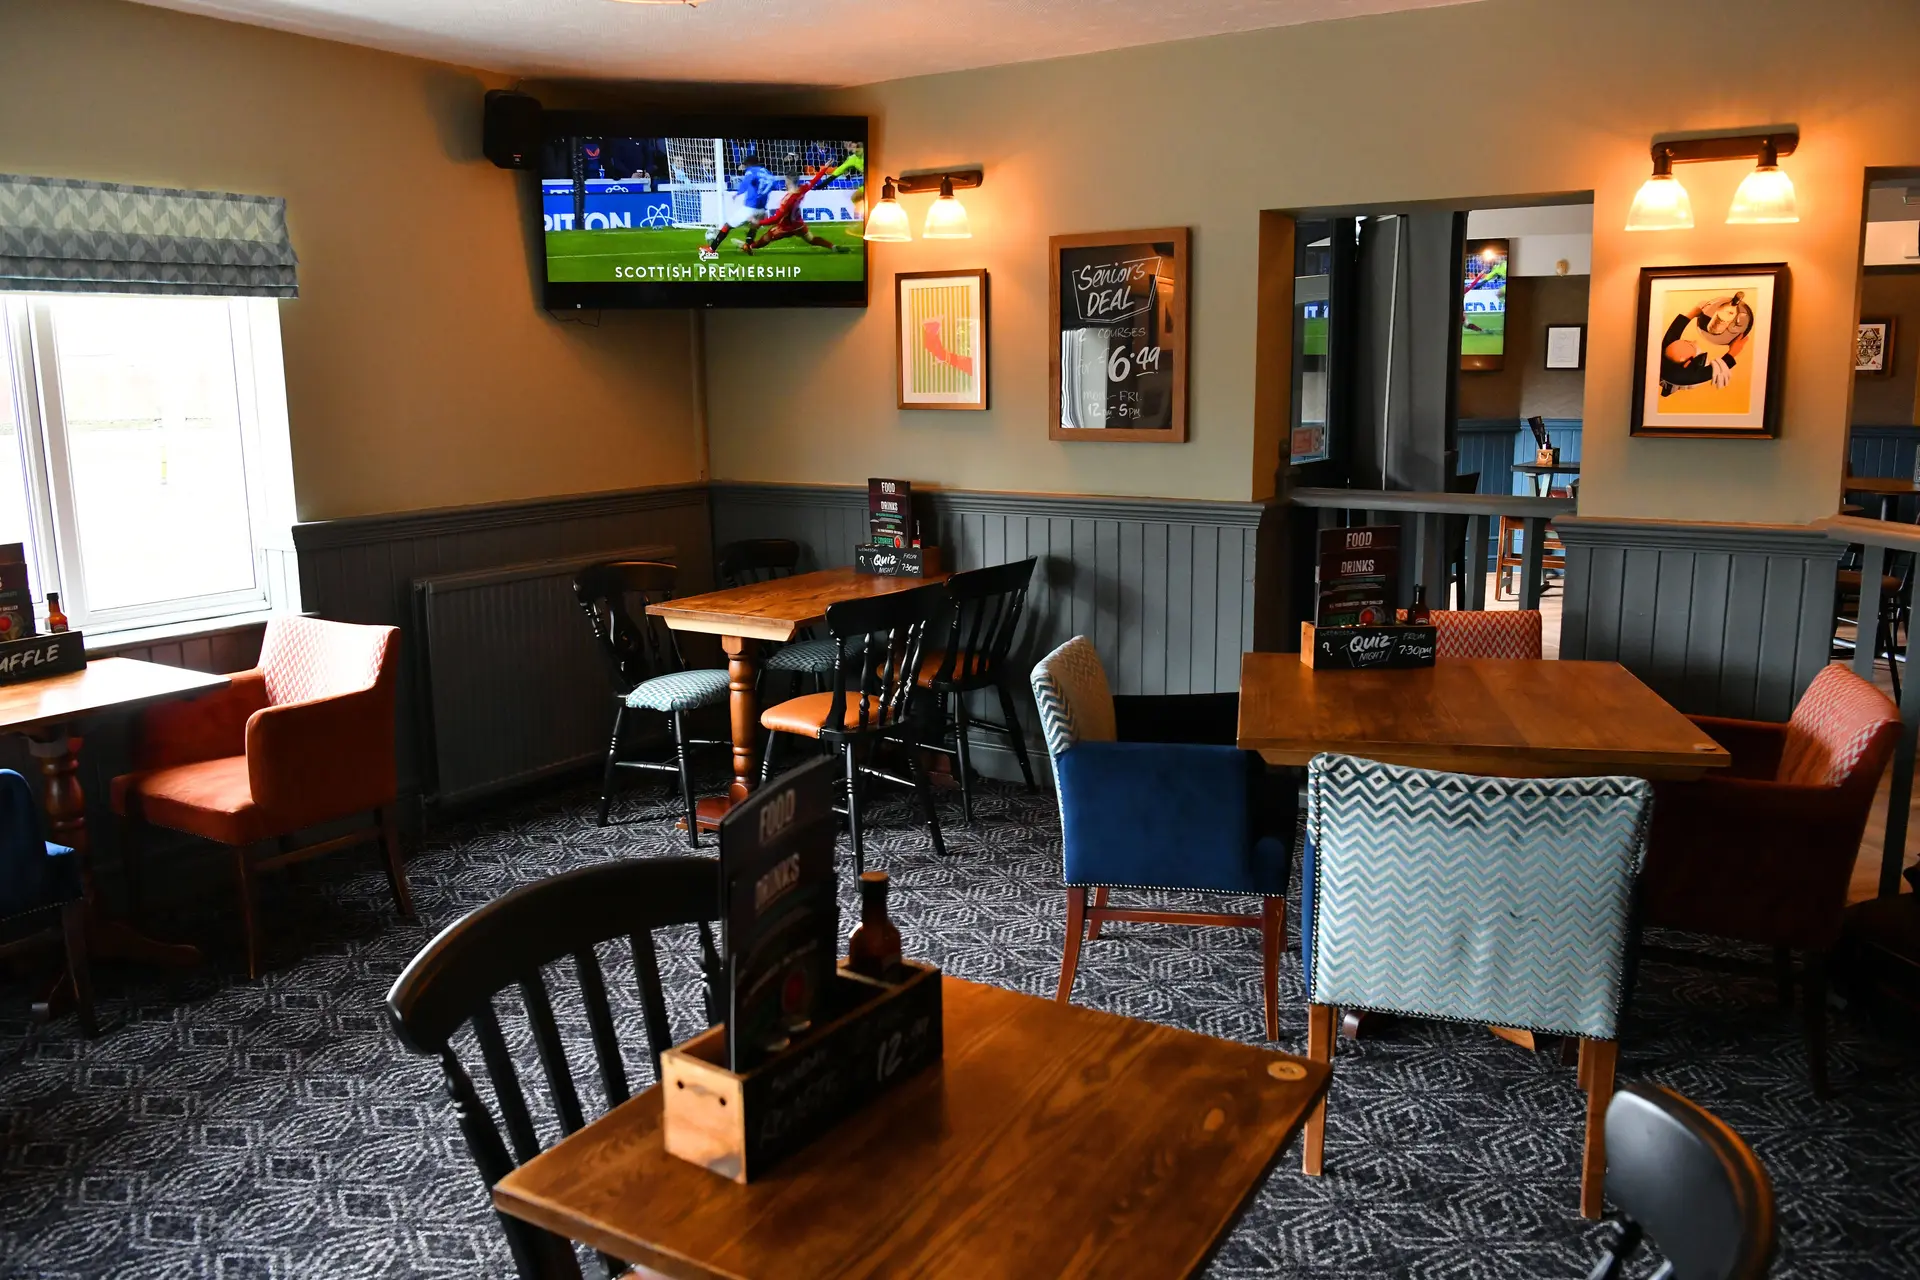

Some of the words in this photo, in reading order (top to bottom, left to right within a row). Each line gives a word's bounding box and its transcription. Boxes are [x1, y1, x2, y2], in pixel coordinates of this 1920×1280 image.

[615, 266, 692, 278] SCOTTISH
[699, 266, 802, 278] PREMIERSHIP
[1078, 262, 1146, 291] Seniors
[1087, 285, 1135, 317] DEAL
[1097, 327, 1146, 340] COURSES
[881, 481, 896, 493] FOOD
[880, 500, 898, 512] DRINKS
[1346, 531, 1372, 548] FOOD
[1340, 559, 1375, 573] DRINKS
[1403, 632, 1426, 641] FROM
[1358, 650, 1385, 662] NIGHT
[757, 788, 796, 844] FOOD
[753, 852, 801, 911] DRINKS
